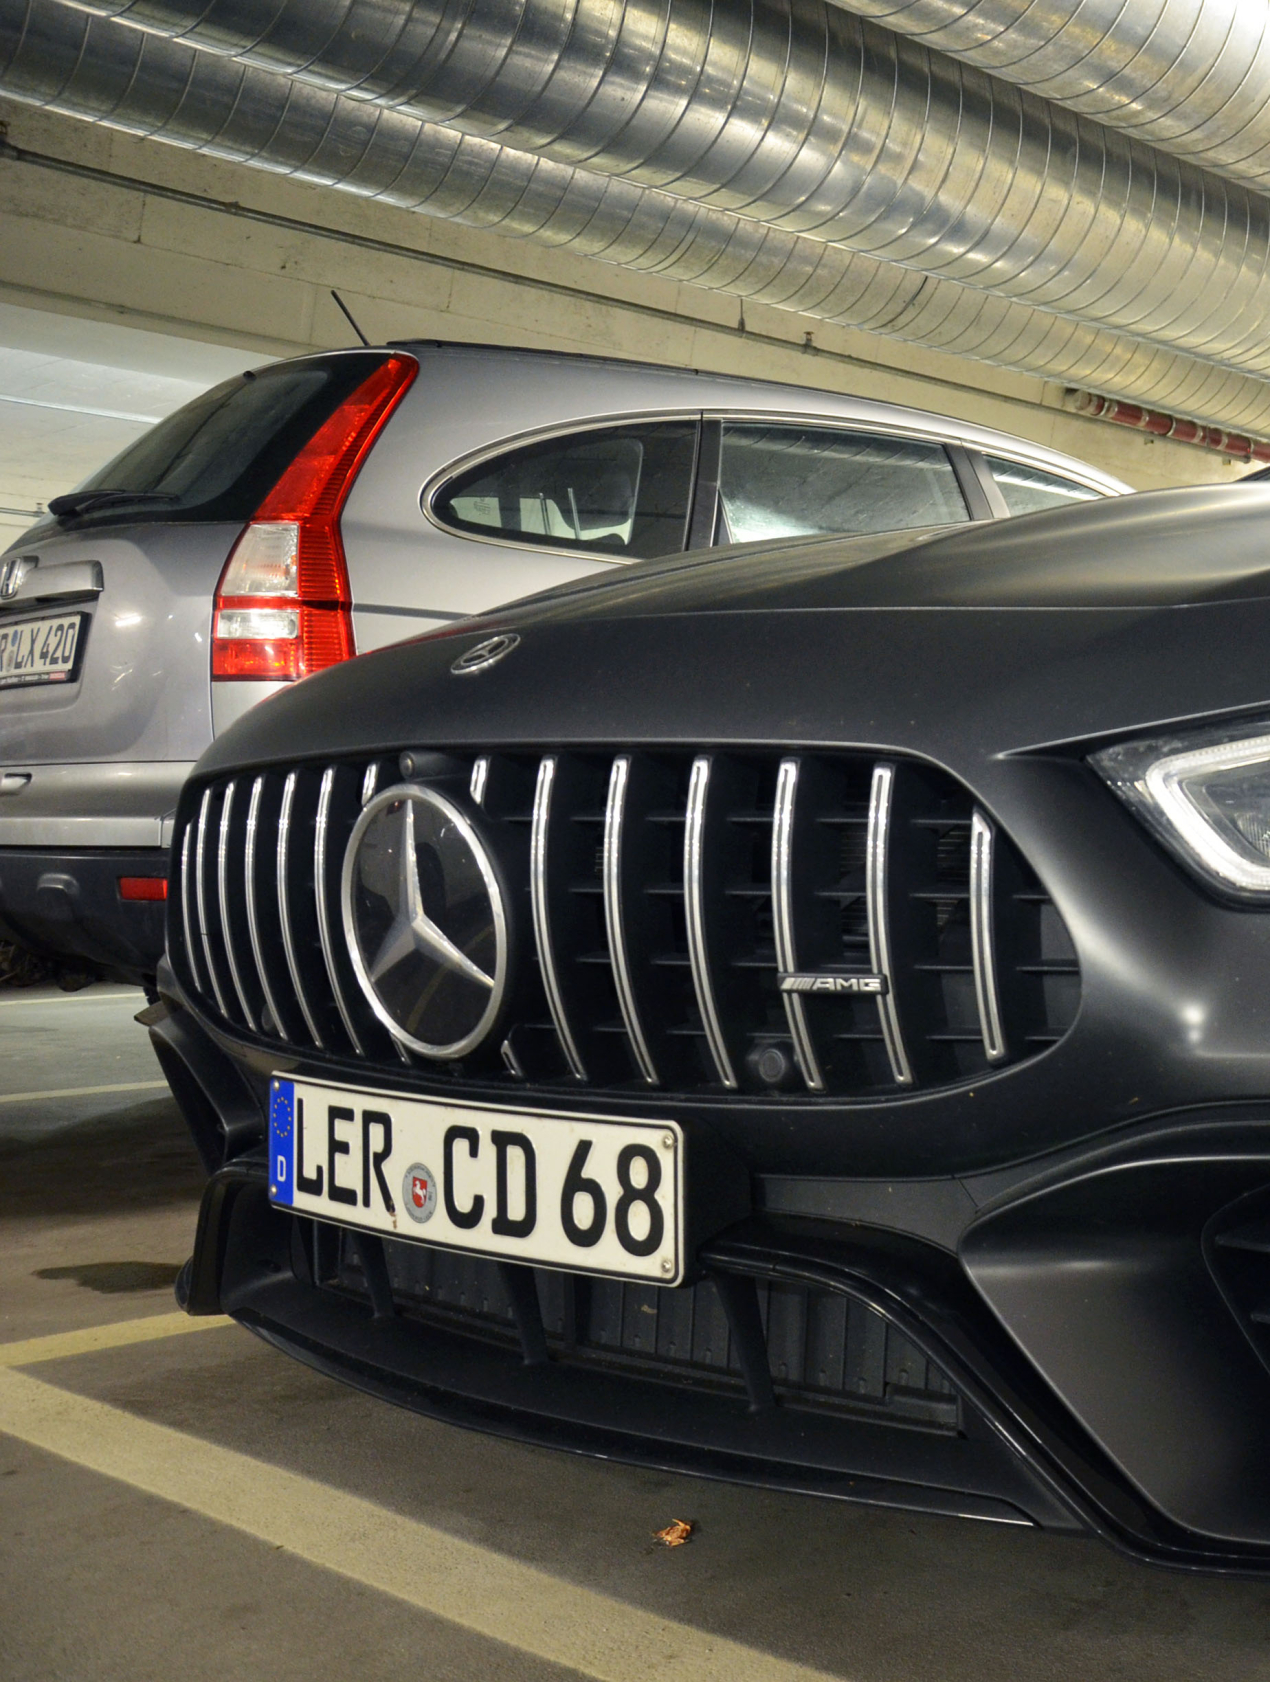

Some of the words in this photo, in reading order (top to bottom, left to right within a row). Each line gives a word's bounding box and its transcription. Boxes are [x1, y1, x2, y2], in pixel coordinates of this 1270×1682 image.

[14, 627, 41, 670] LX
[39, 622, 76, 666] 420
[276, 1155, 287, 1182] D
[296, 1097, 396, 1214] LER
[443, 1124, 537, 1239] CD
[560, 1139, 664, 1257] 68
